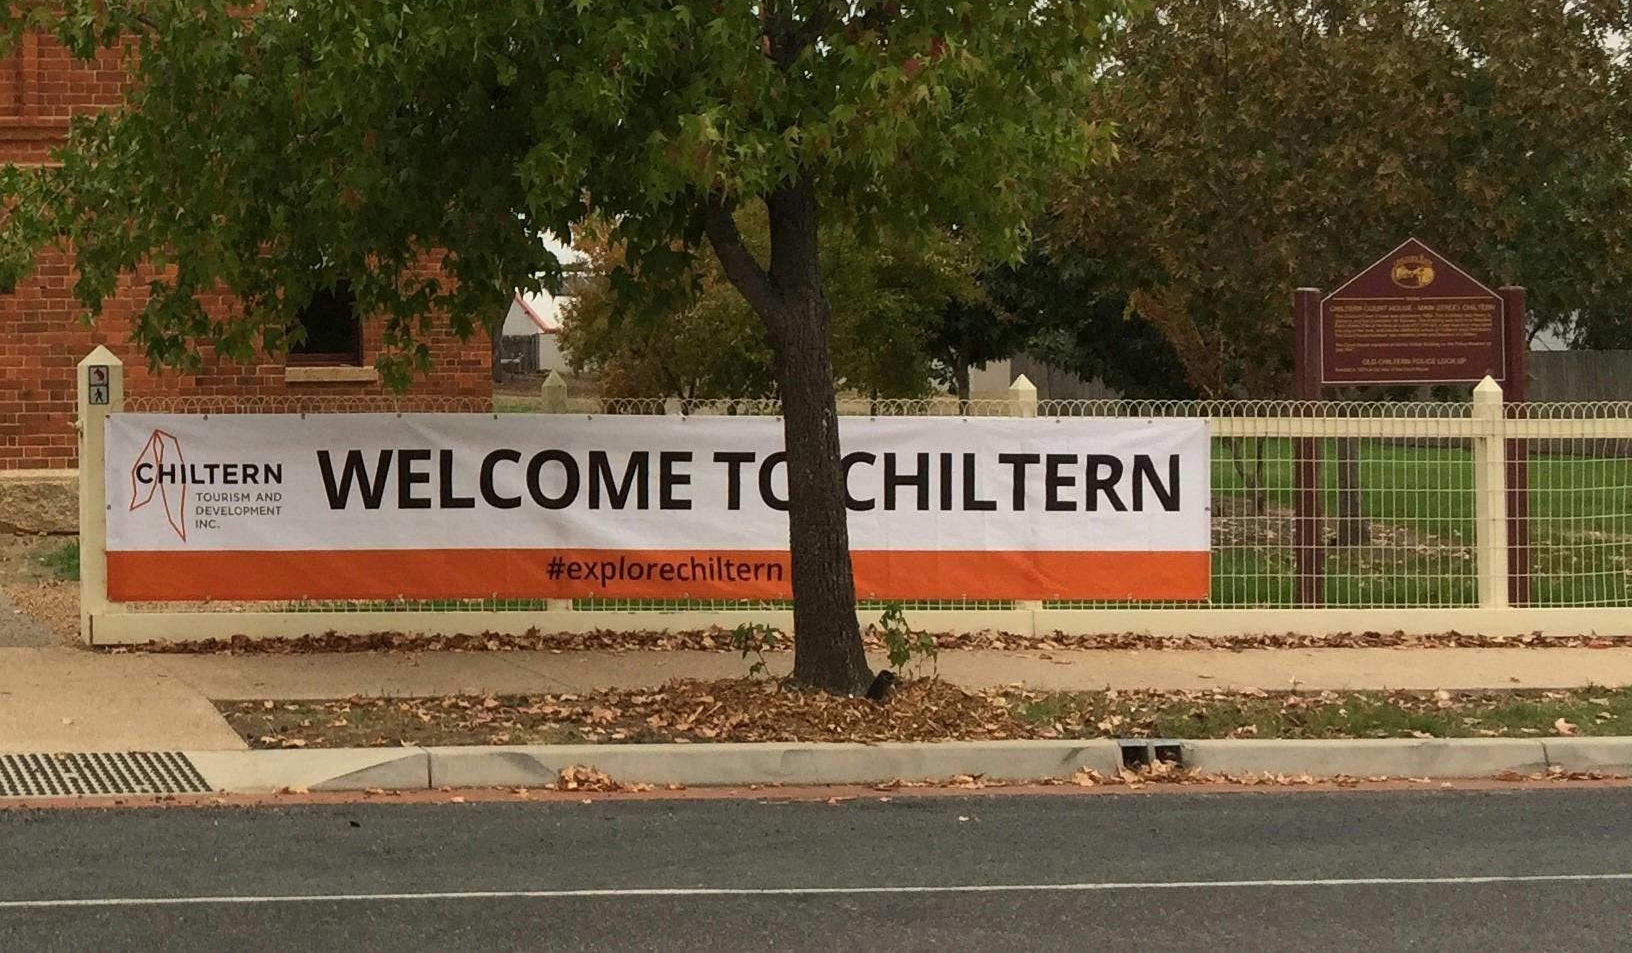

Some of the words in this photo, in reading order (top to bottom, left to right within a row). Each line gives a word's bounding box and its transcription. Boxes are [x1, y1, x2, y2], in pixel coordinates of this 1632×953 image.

[135, 462, 283, 485] CHILTERN
[316, 449, 693, 511] WELCOME
[713, 451, 789, 512] TO
[841, 451, 1180, 513] CHILTERN
[195, 492, 251, 503] TOURISM
[255, 492, 283, 503] AND
[195, 506, 283, 516] DEVELOPMENT
[195, 519, 222, 529] INC.
[546, 555, 784, 588] #explorechiltern
